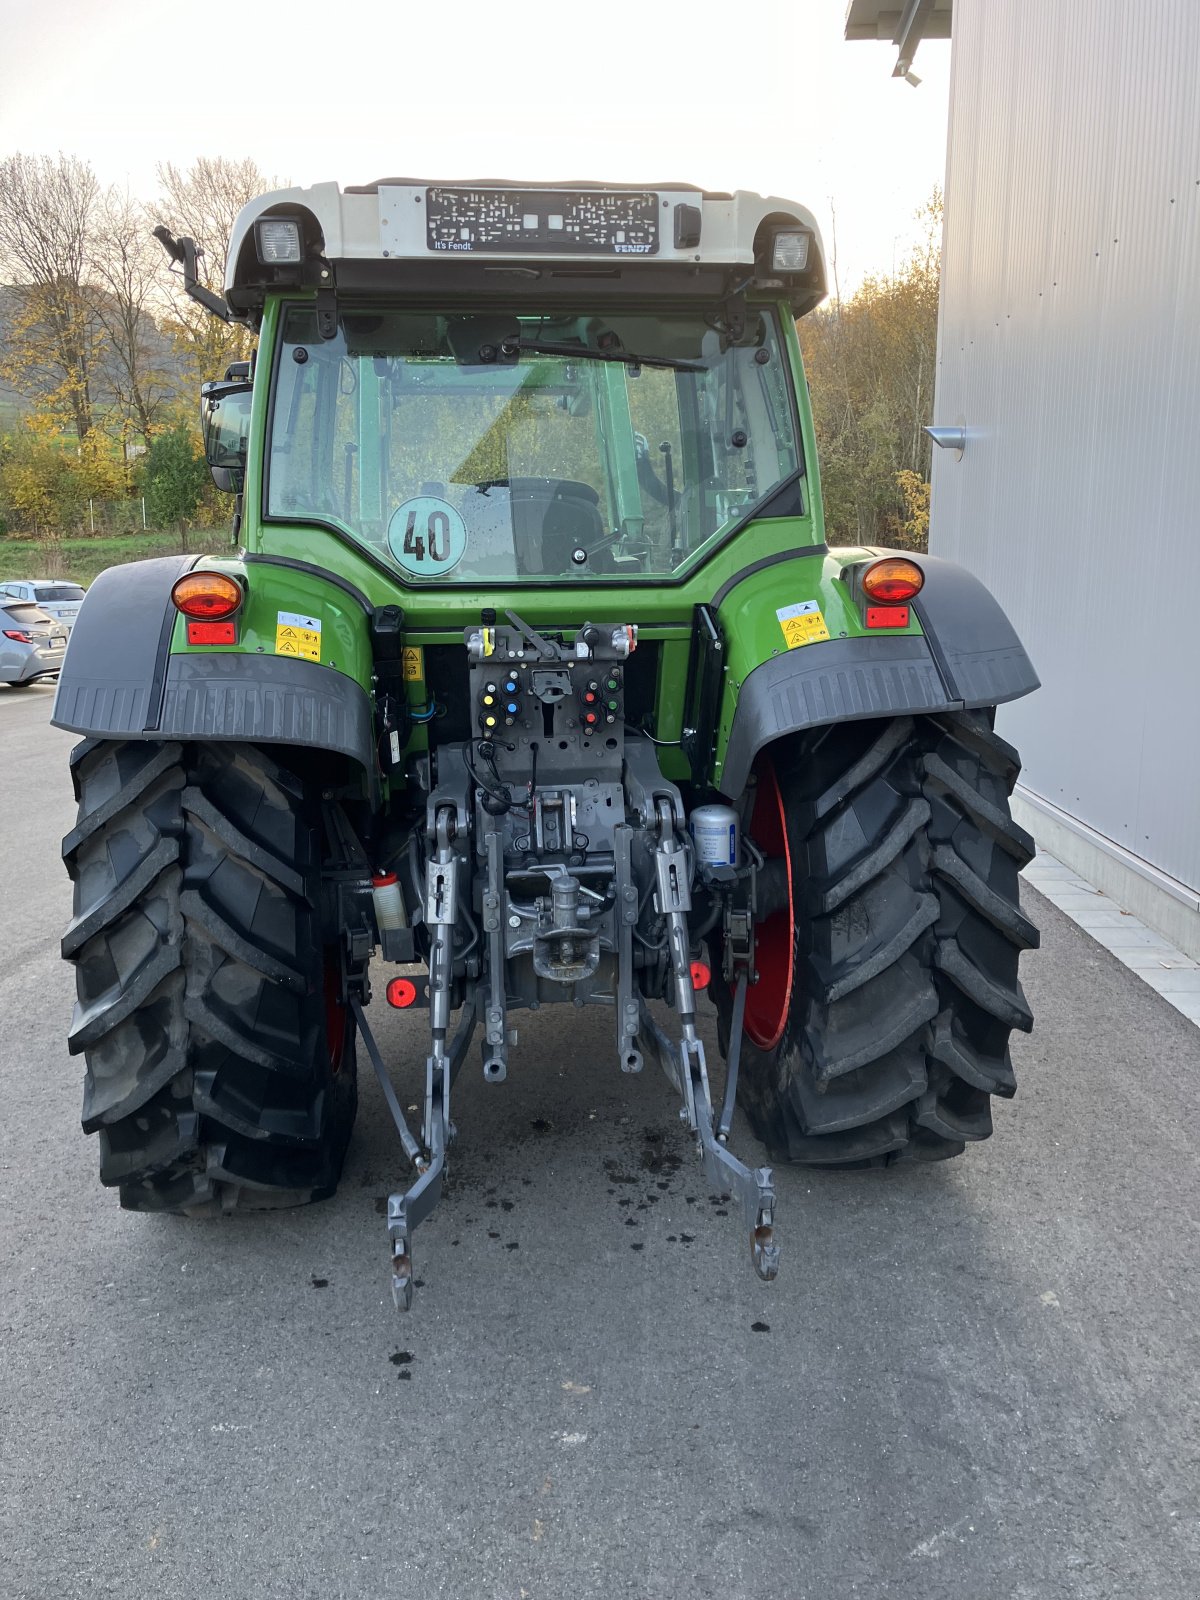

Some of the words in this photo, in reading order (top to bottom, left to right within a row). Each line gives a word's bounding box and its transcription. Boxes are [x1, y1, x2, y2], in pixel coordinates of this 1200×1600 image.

[435, 241, 446, 250] It's
[448, 241, 473, 251] Fendt.
[614, 244, 652, 253] FENDT
[403, 511, 451, 562] 40
